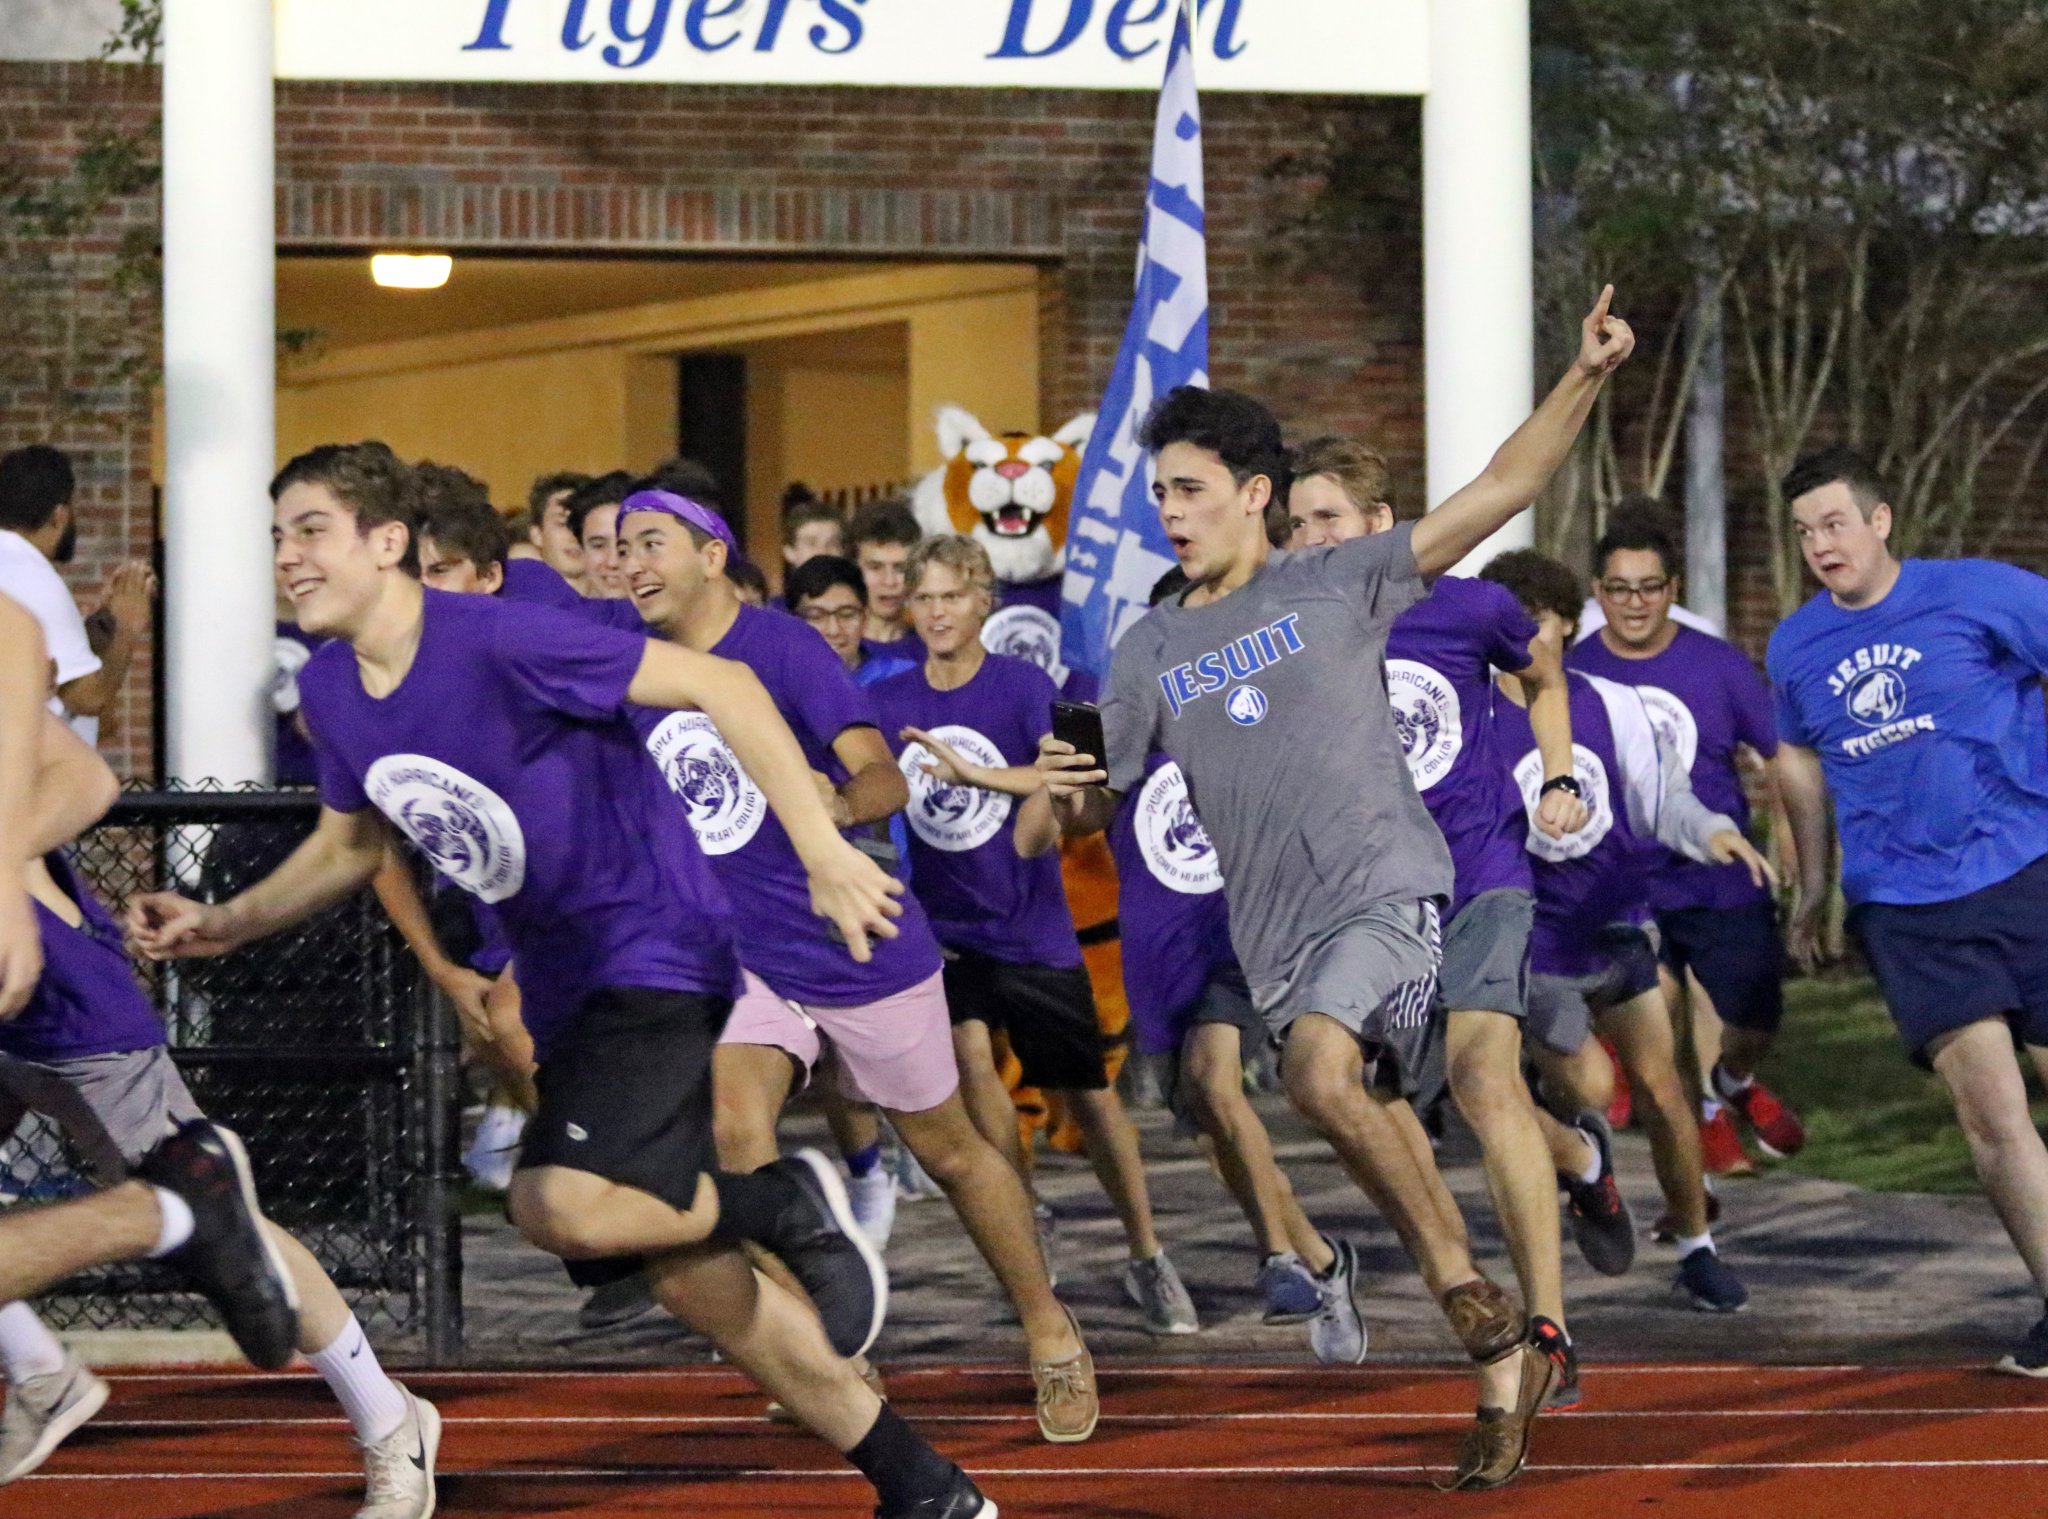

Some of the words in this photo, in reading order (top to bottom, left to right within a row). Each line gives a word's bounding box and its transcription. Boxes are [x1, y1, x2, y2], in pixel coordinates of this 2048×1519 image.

[1158, 612, 1305, 721] JESUIT
[1827, 643, 1922, 697] JESUIT
[1842, 713, 1936, 757] TIGERS
[1146, 771, 1183, 815] PURPLE
[705, 827, 735, 842] HEART
[1180, 871, 1210, 883] HEART
